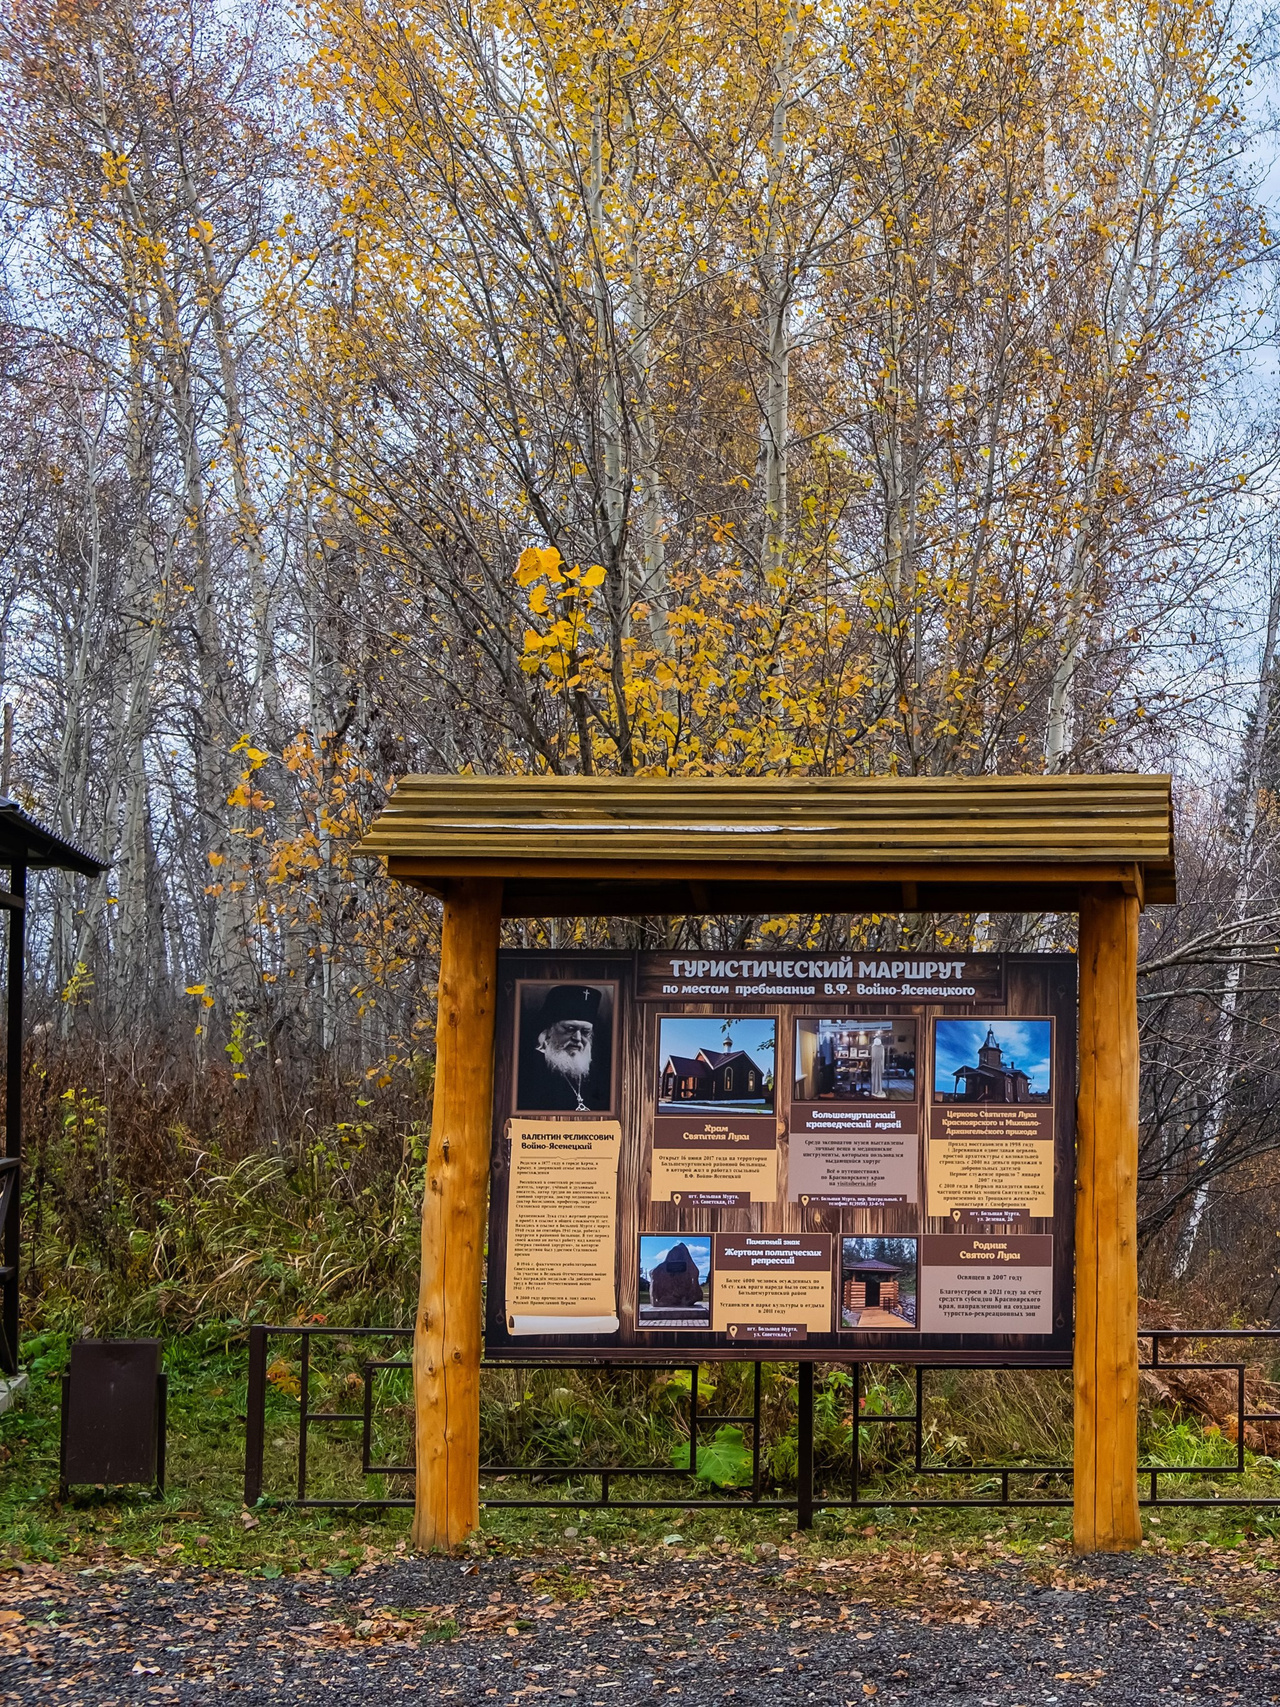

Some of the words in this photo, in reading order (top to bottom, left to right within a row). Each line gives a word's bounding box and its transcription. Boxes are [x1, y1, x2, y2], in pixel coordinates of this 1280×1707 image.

[669, 959, 856, 978] ТУРИСТИЧЕСКИЙ
[856, 961, 966, 979] МАРШРУТ
[663, 985, 679, 994] по
[681, 985, 729, 994] местам
[735, 983, 815, 997] пребывания
[824, 983, 850, 995] В.Ф.
[857, 984, 975, 997] Войно-Ясенецкого
[812, 1111, 896, 1120] Большемуртинский
[947, 1110, 978, 1119] Церковь
[1018, 1111, 1037, 1120] Луки
[704, 1124, 728, 1133] Храм
[806, 1120, 872, 1130] краеведческий
[875, 1120, 902, 1130] музей
[942, 1119, 998, 1128] Красноярского
[946, 1127, 1004, 1136] Архангельского
[683, 1132, 726, 1140] Святителя
[727, 1132, 750, 1142] Луки
[521, 1142, 592, 1150] Войно-Ясенецкий
[973, 1241, 1007, 1251] Родник
[725, 1248, 764, 1258] Жертвам
[959, 1250, 995, 1259] Святого
[997, 1251, 1021, 1261] Луки
[751, 1257, 795, 1266] репрессий
